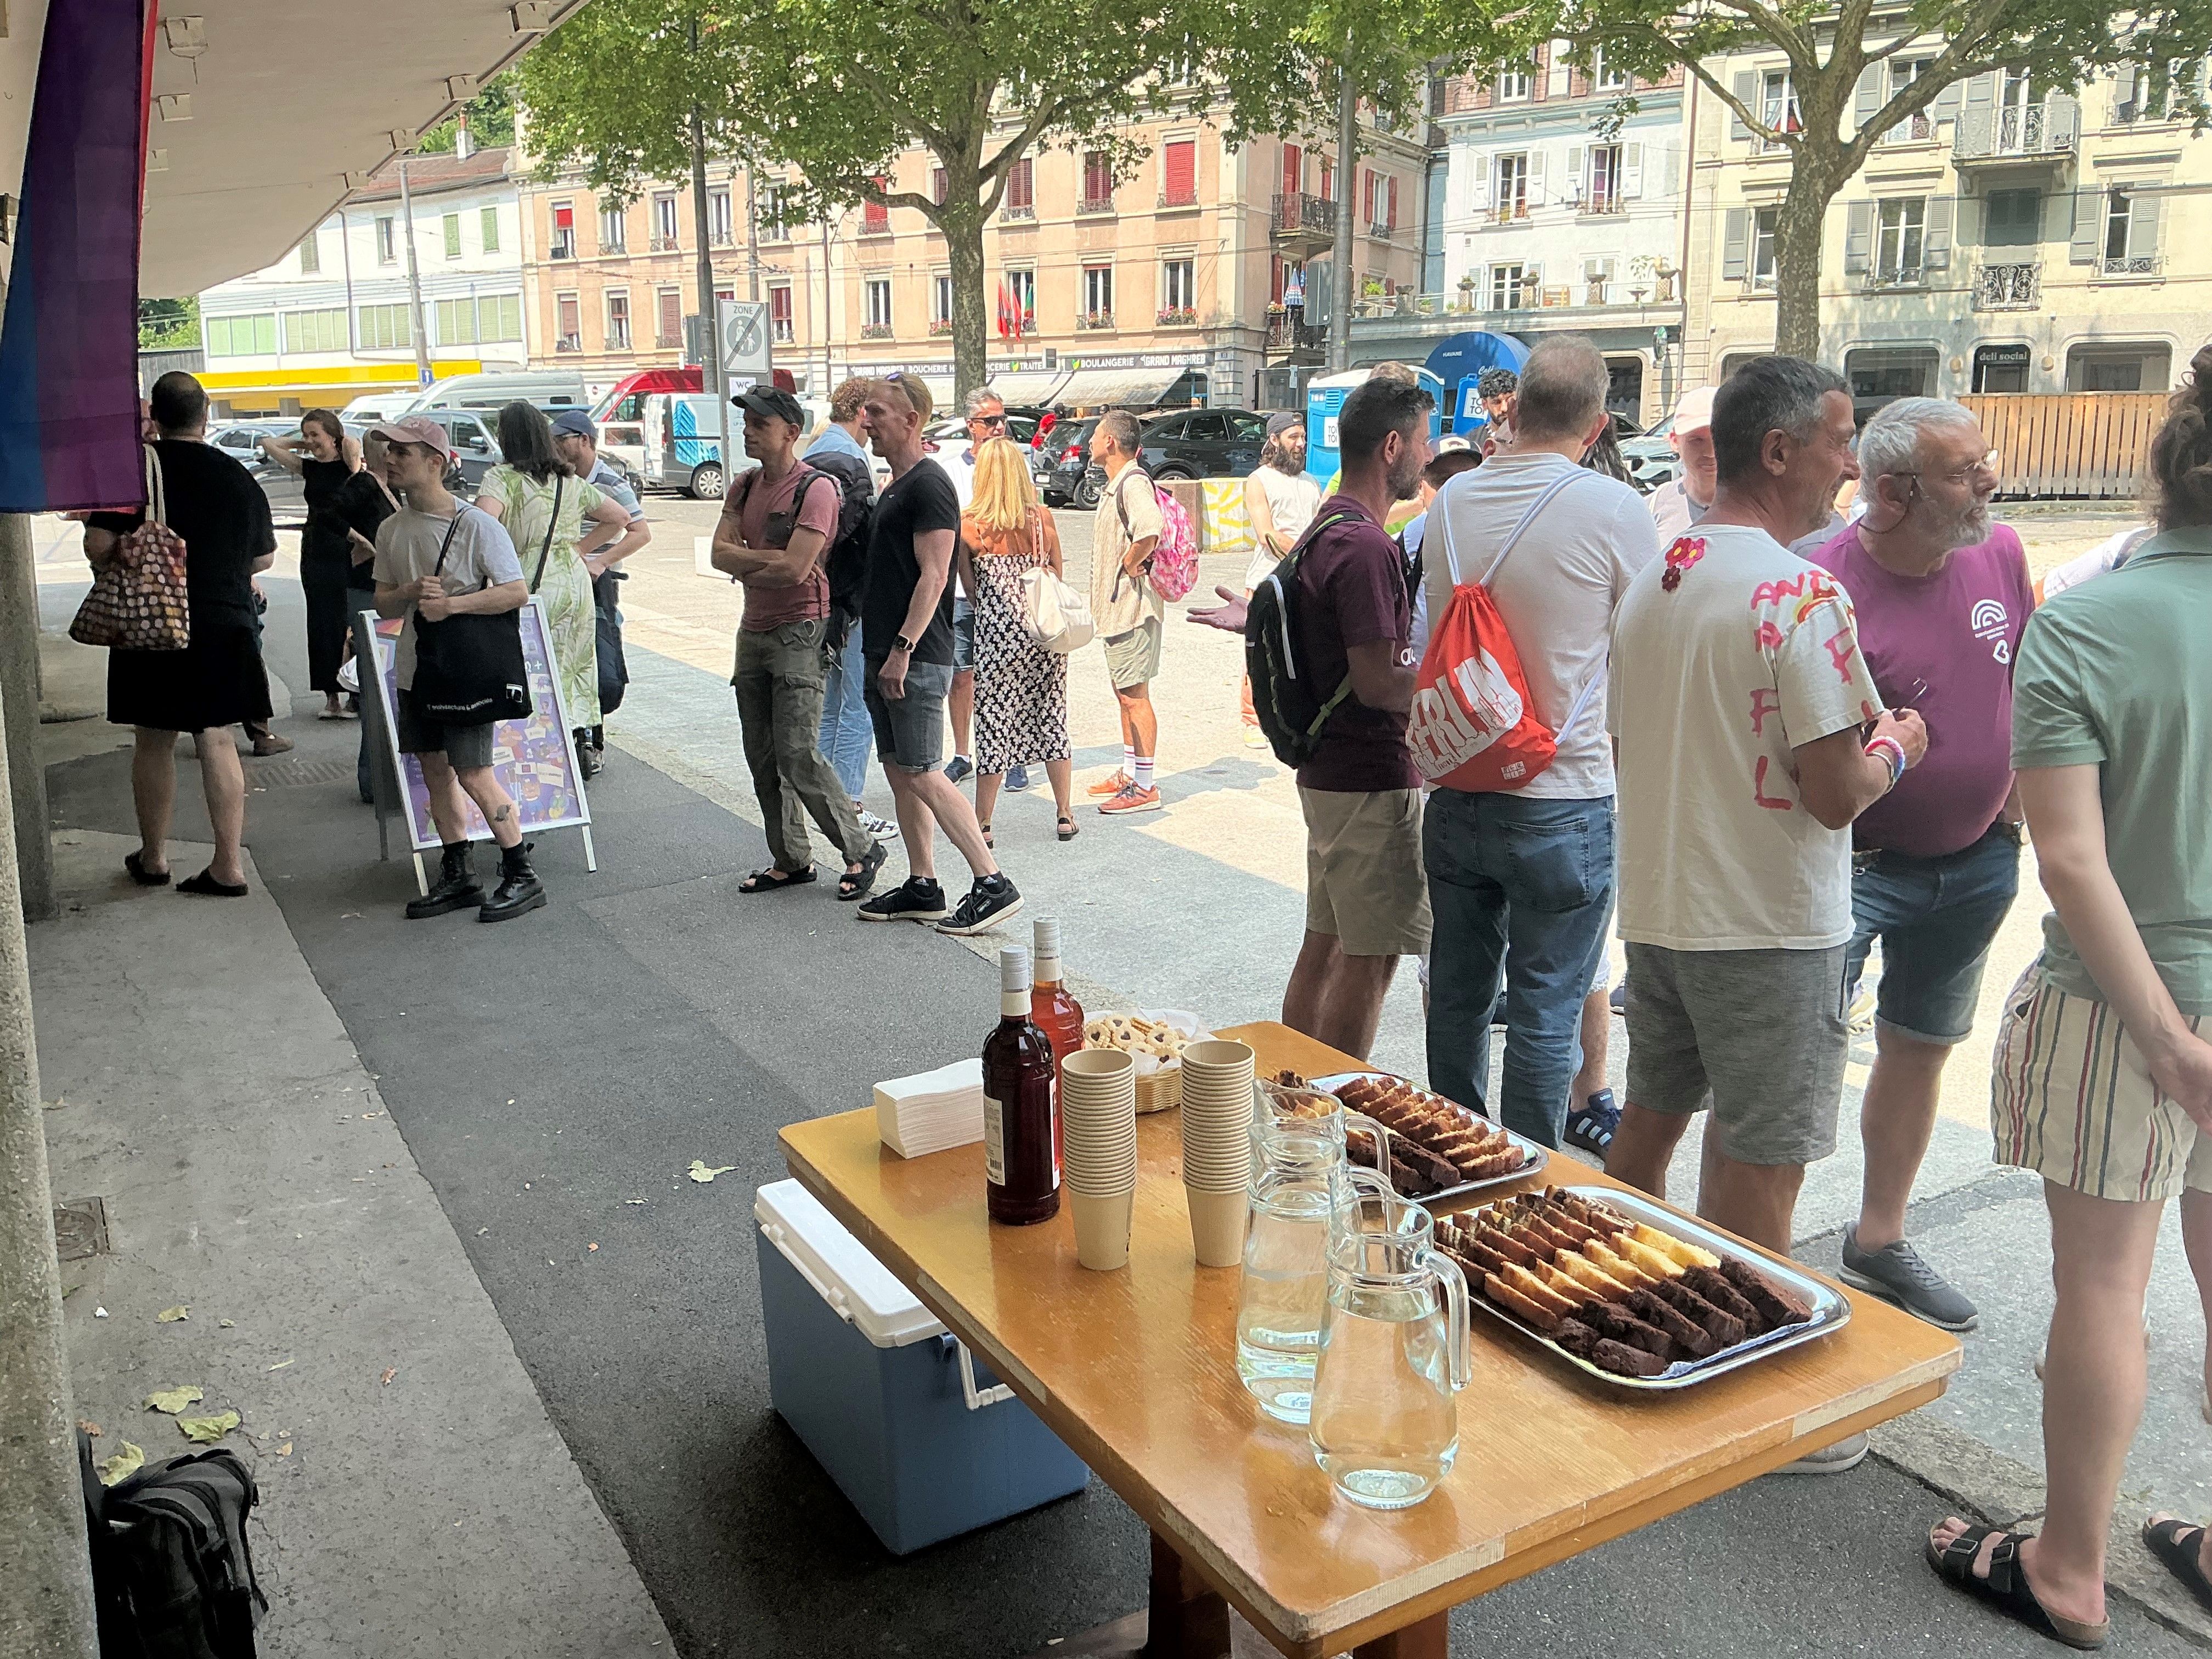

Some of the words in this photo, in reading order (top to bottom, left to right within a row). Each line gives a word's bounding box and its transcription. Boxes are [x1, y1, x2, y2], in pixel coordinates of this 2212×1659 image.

[733, 305, 753, 314] ZONE
[1999, 351, 2027, 360] social
[1081, 358, 1135, 368] BOULANGERIE
[1144, 356, 1170, 366] GRAND
[1171, 354, 1206, 365] MAGHREB
[909, 364, 947, 374] BOUCHERIE
